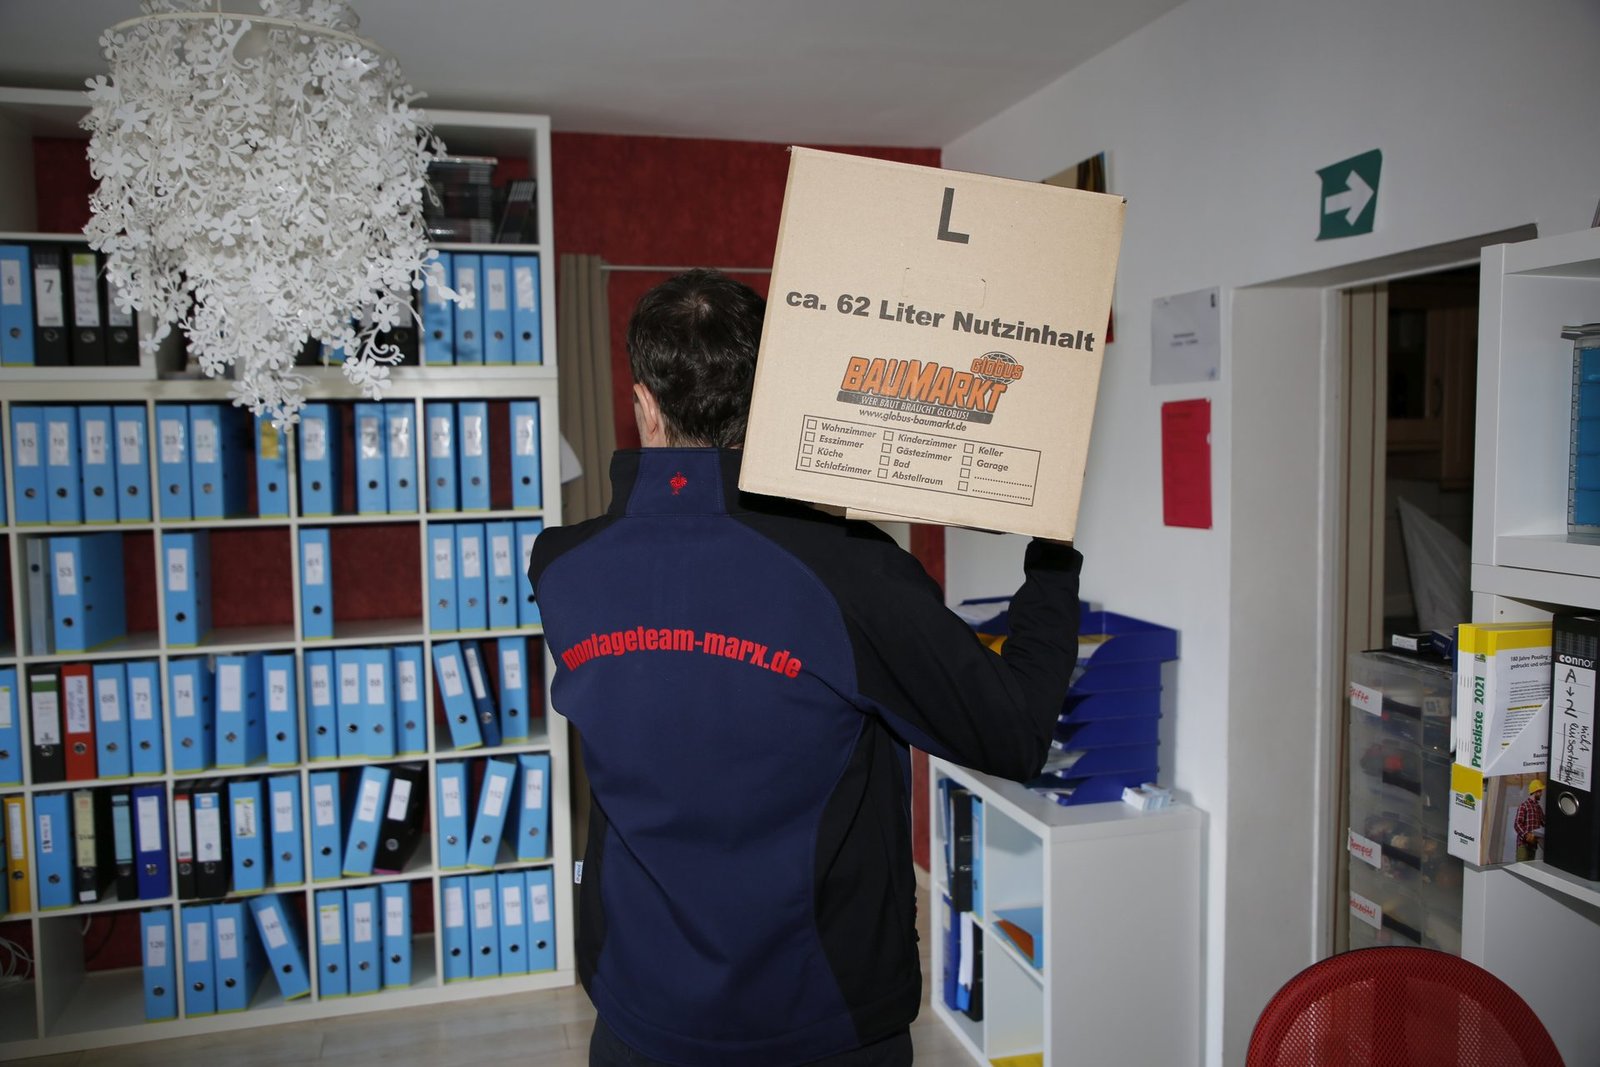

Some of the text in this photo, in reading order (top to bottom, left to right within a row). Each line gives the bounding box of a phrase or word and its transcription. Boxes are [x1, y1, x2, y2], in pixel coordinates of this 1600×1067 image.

[936, 186, 970, 245] L
[43, 280, 54, 294] 7
[785, 290, 1096, 353] ca. 62 Liter Nutzinhalt
[840, 356, 1008, 413] BAUMARKT
[860, 395, 970, 420] WER BAUT BRAUCHT GLOBUS!
[858, 408, 967, 432] www.globus-baumarkt.de
[821, 422, 877, 439] Wohnzimmer
[21, 438, 34, 448] 15
[90, 436, 102, 447] 17
[818, 435, 864, 449] Esszimmer
[897, 433, 958, 451] Kinderzimmer
[817, 446, 844, 459] Küche
[895, 445, 953, 463] Gästezimmer
[978, 446, 1004, 458] Keller
[814, 459, 872, 477] Schlafzimmer
[893, 458, 911, 469] Bad
[976, 459, 1009, 473] Garage
[891, 470, 943, 486] Abstellraum
[561, 625, 802, 679] montageteam-marx.de
[1559, 653, 1594, 668] connor
[1564, 668, 1577, 684] A
[177, 690, 190, 700] 74
[1474, 676, 1486, 705] 2021
[1471, 710, 1484, 769] Preisliste
